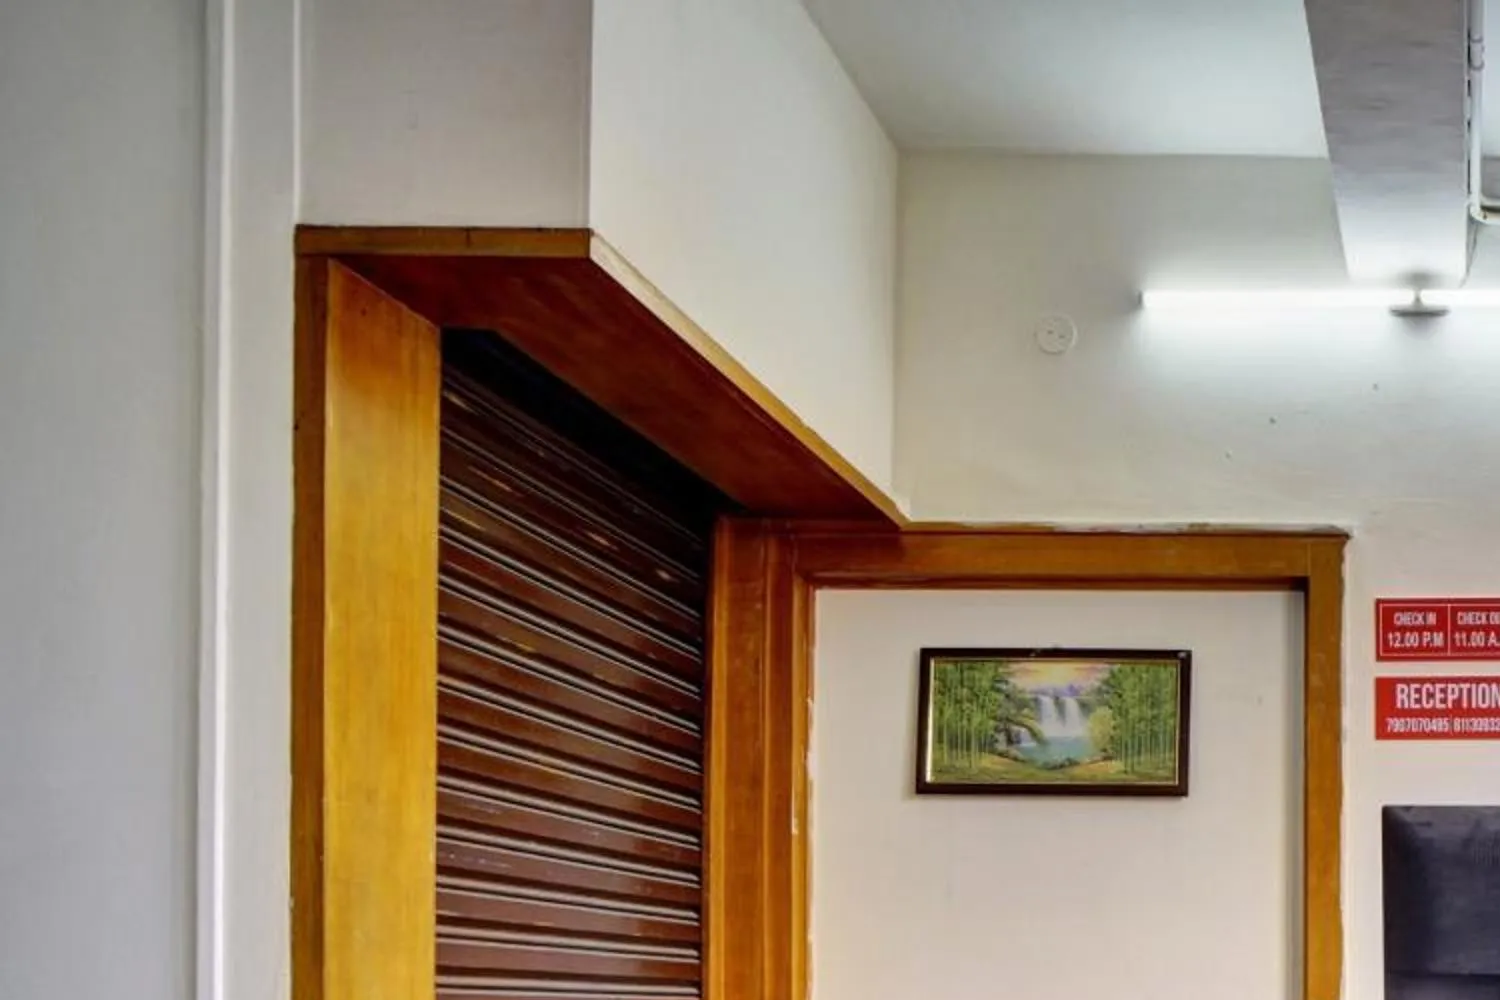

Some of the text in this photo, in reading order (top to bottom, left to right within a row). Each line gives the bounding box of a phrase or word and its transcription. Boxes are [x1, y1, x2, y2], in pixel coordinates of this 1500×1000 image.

[1393, 612, 1437, 625] CHECK IN
[1457, 611, 1488, 625] CHECK
[1387, 632, 1444, 648] 12.00 P.M
[1454, 631, 1485, 647] 11.00
